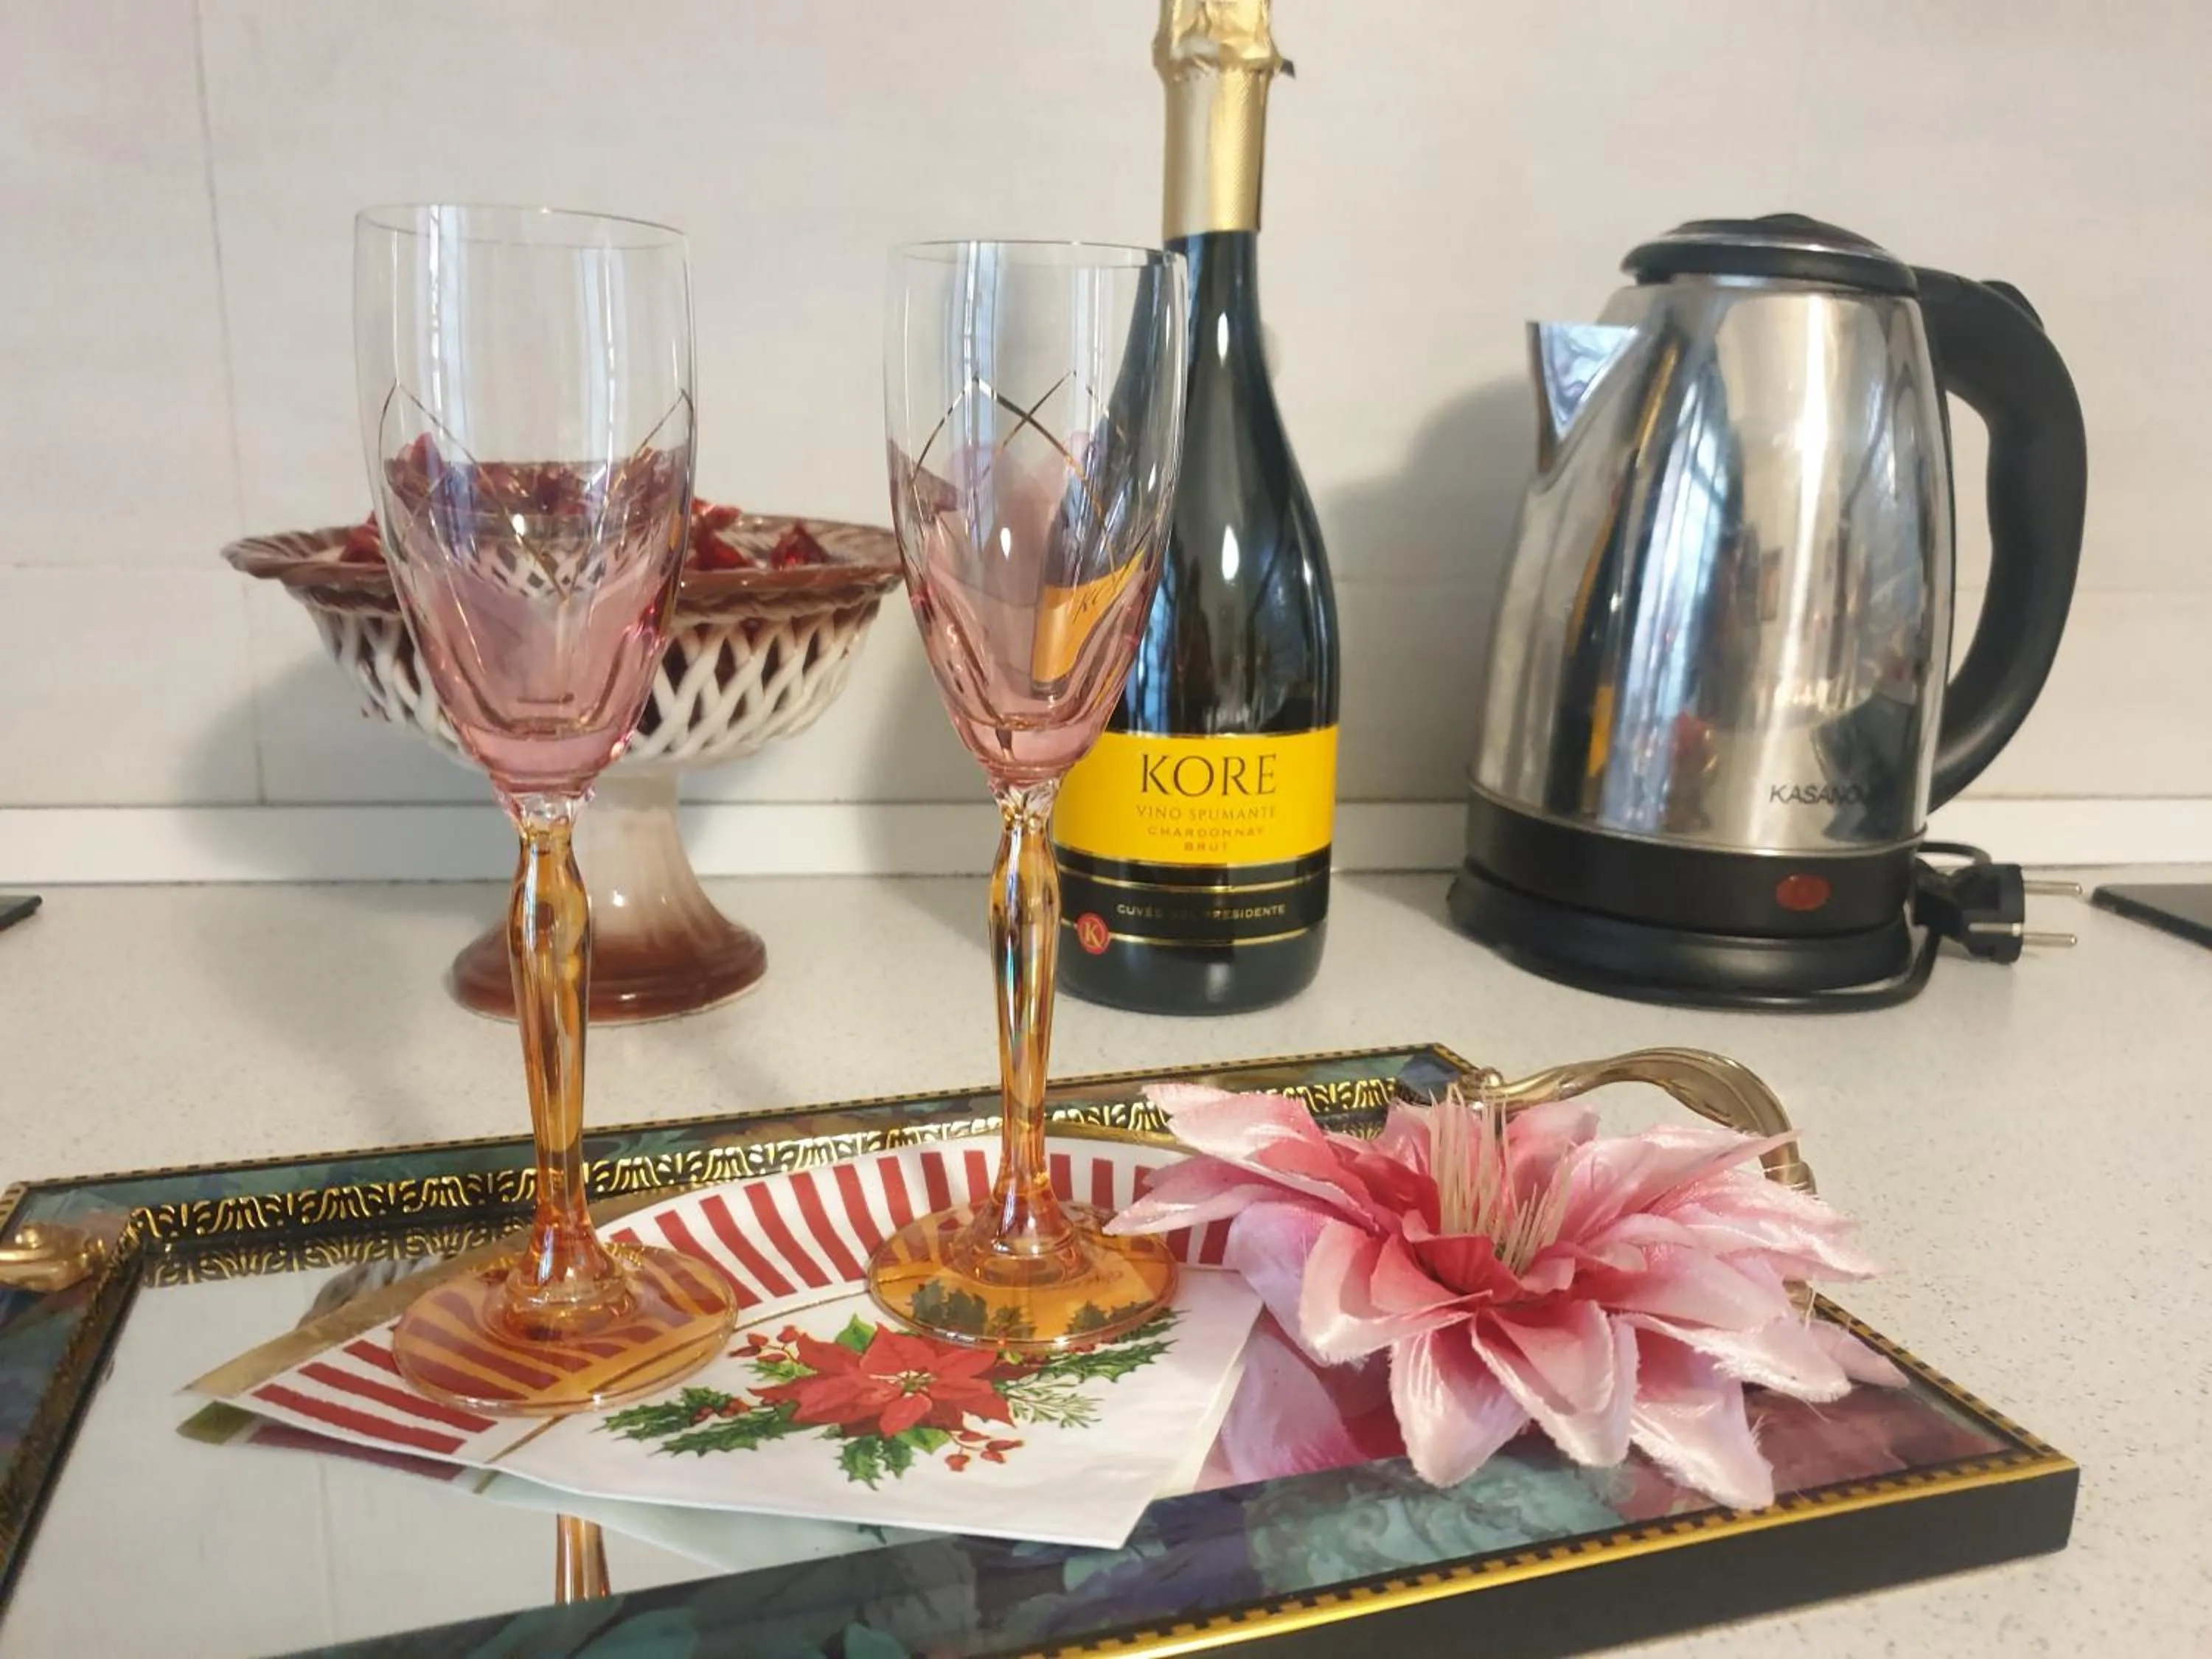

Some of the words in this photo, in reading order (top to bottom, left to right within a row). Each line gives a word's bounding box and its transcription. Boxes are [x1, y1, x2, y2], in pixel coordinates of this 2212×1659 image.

[1141, 754, 1277, 797] KORE
[1136, 804, 1181, 820] VINO
[1188, 805, 1276, 821] SPUMANTE
[1147, 827, 1265, 838] CHARDONNAY
[1184, 841, 1228, 852] BRUT
